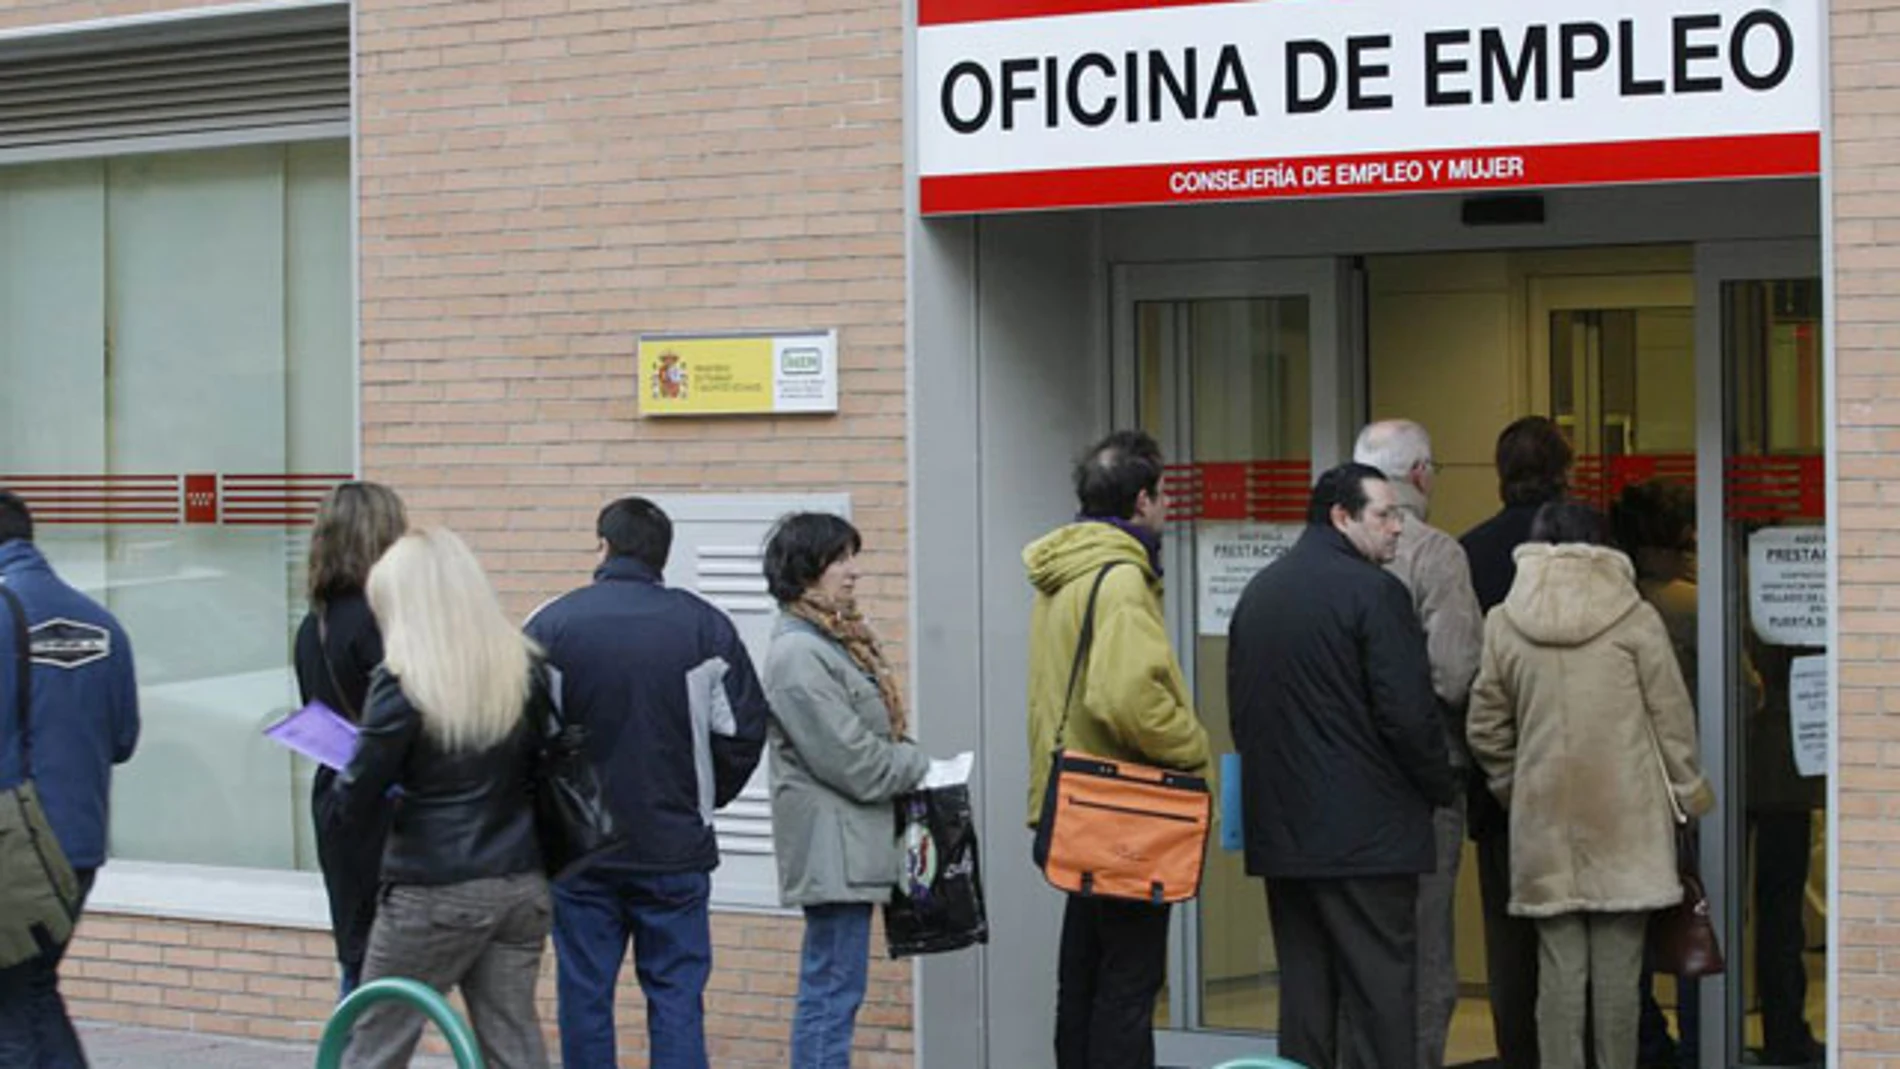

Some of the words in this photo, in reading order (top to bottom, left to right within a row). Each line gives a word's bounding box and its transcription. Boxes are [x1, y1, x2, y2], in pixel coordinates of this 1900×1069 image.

[941, 44, 1258, 134] OFICINA
[1285, 34, 1394, 114] DE
[1424, 9, 1794, 107] EMPLEO
[1169, 162, 1298, 193] CONSEJERÍA
[1302, 164, 1331, 186] DE
[1335, 161, 1424, 184] EMPLEO
[1427, 160, 1444, 181] Y
[1448, 156, 1525, 178] MUJER
